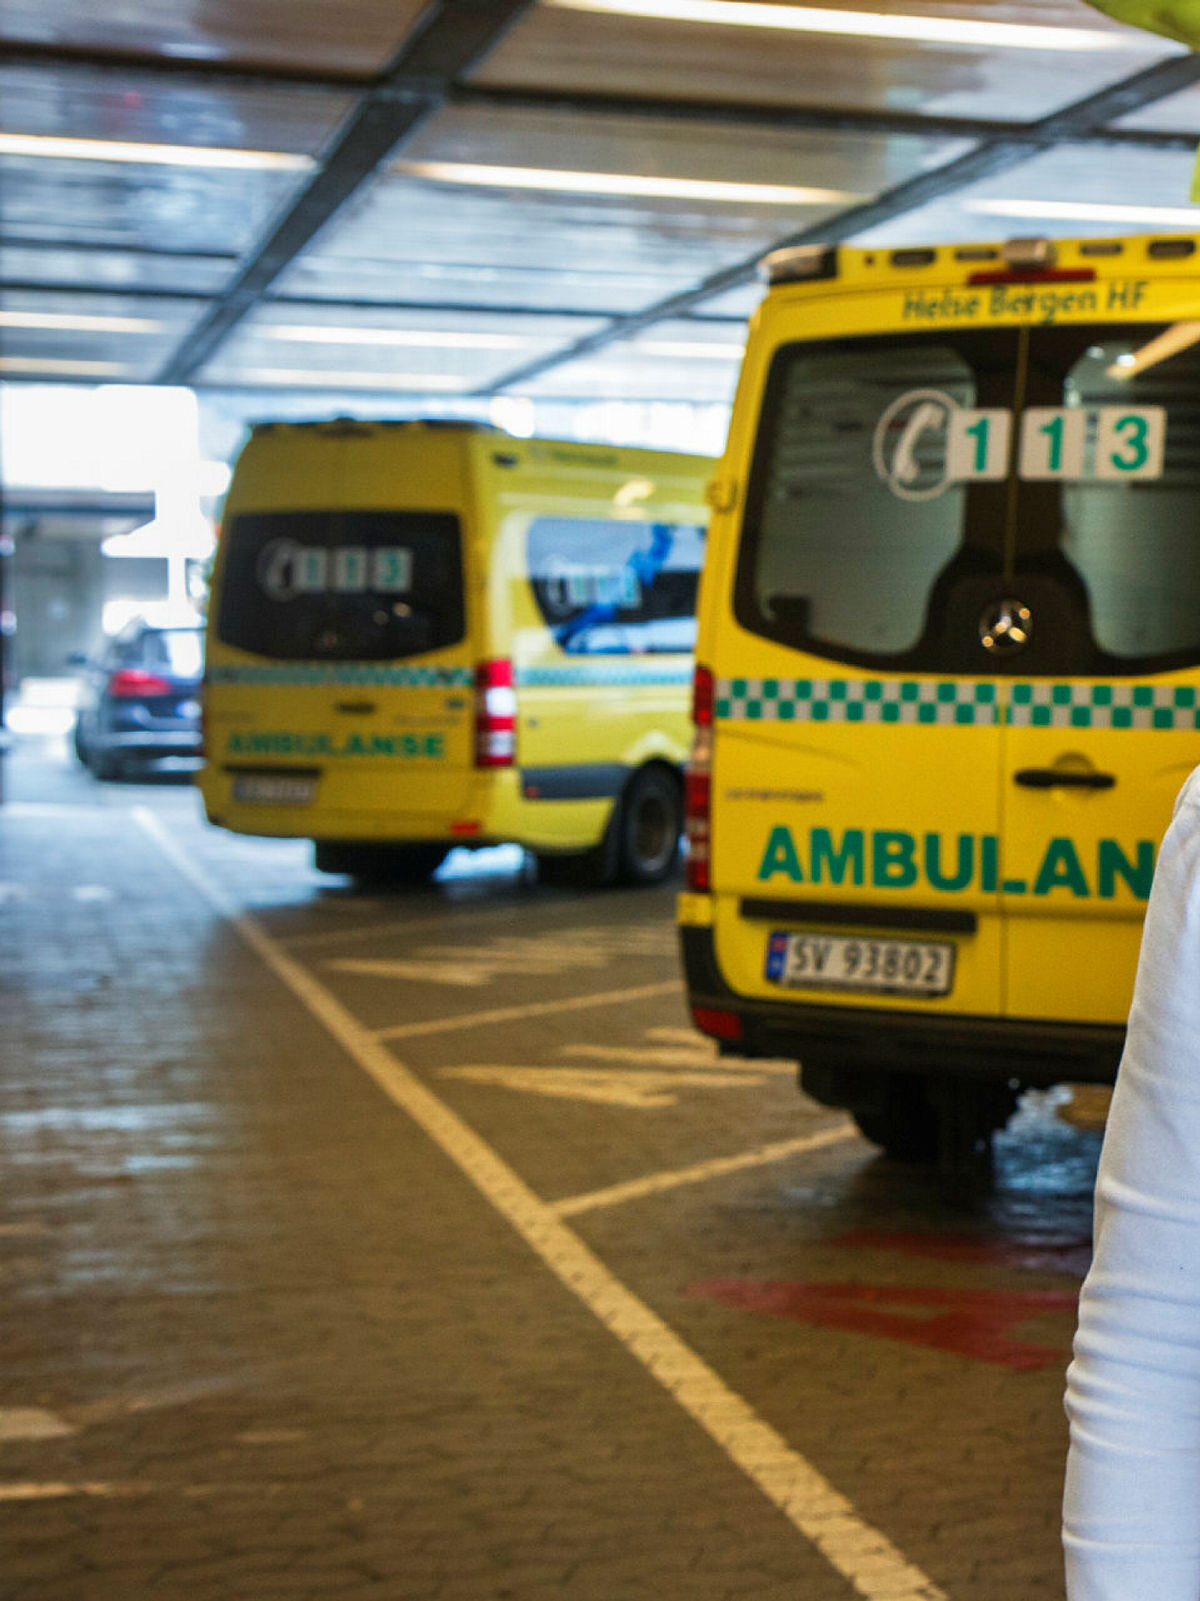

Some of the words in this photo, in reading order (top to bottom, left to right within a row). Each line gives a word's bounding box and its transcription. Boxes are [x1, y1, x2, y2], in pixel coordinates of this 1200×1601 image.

[902, 288, 979, 319] Helse
[990, 283, 1098, 326] Bergen
[1105, 280, 1149, 310] HF
[793, 937, 831, 971] SV
[843, 942, 942, 984] 93802
